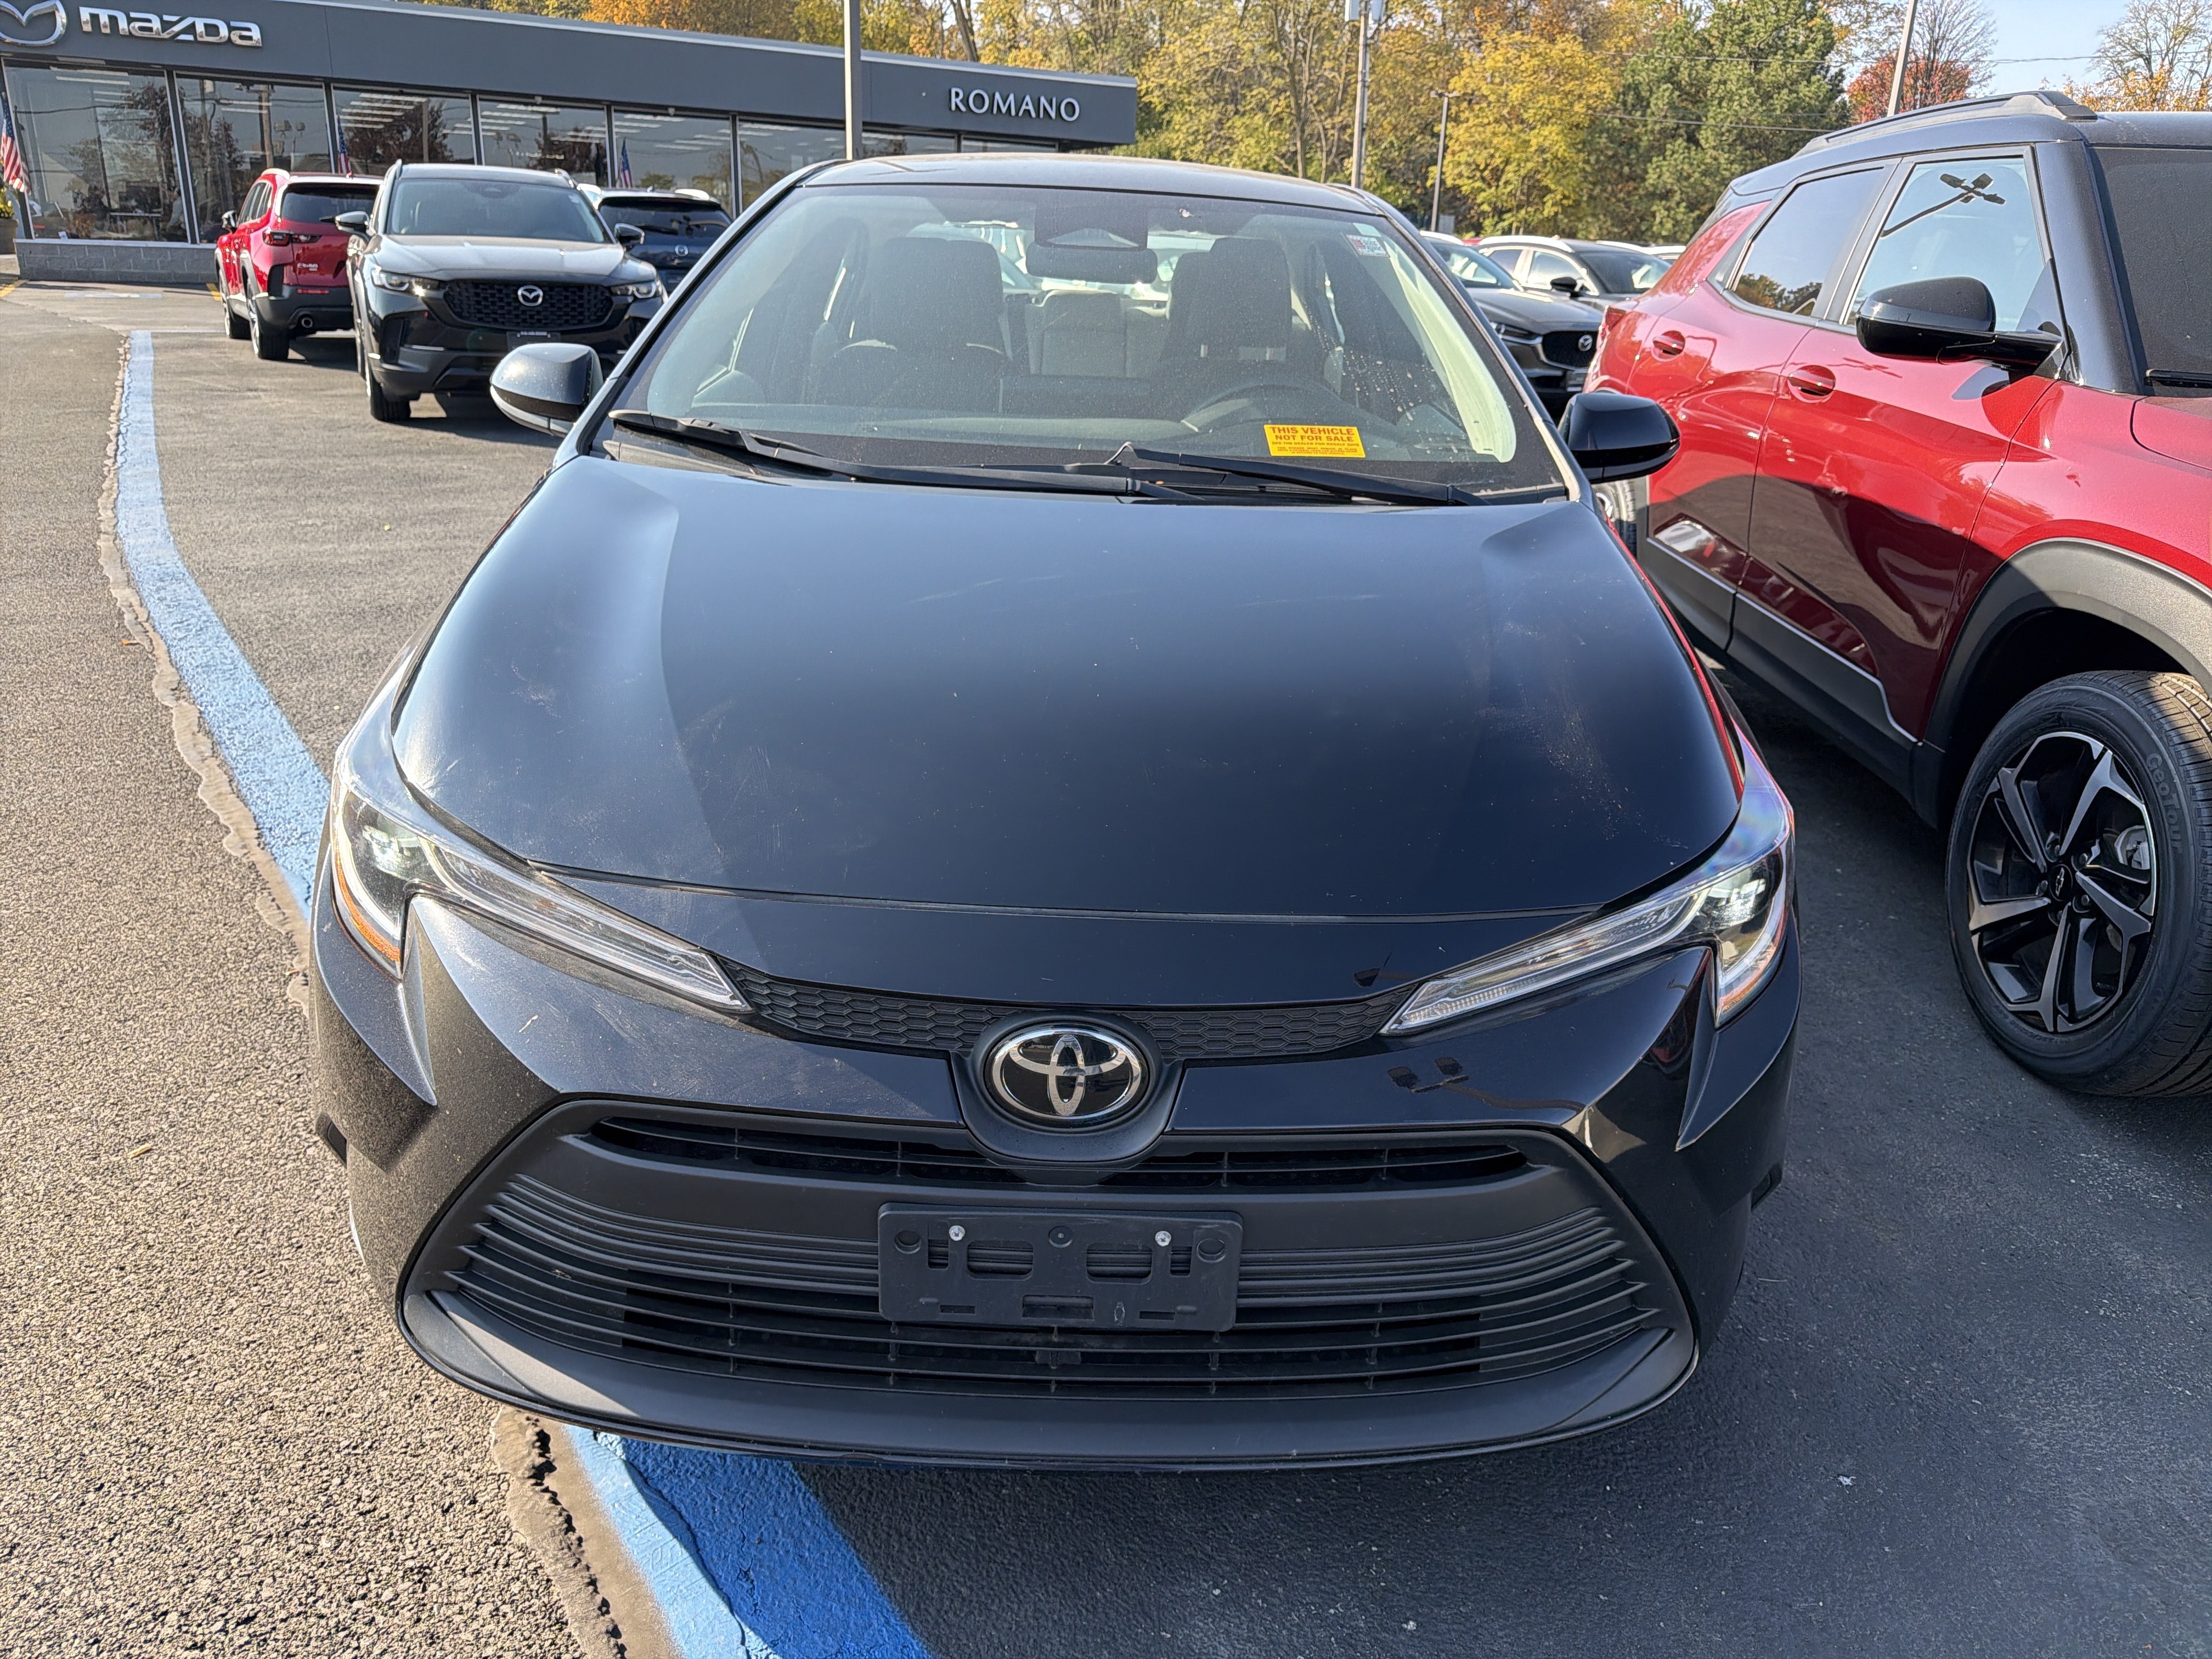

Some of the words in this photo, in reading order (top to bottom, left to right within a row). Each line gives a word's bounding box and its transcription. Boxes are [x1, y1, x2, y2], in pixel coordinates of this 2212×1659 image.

[79, 6, 262, 47] mazda
[951, 87, 1080, 121] ROMANO
[2146, 753, 2183, 854] GeoTour
